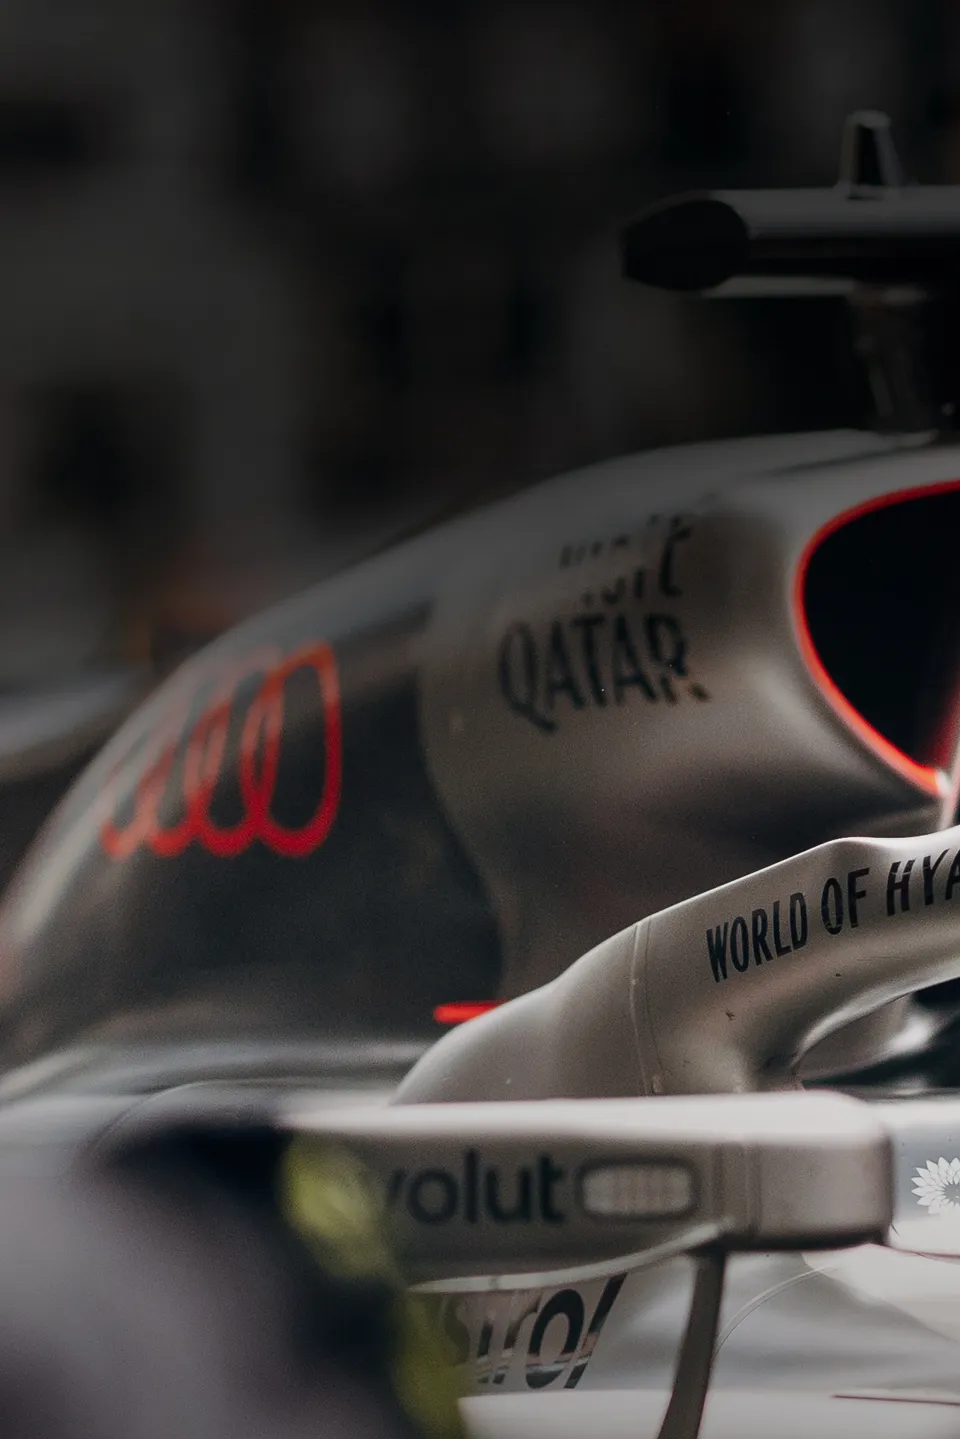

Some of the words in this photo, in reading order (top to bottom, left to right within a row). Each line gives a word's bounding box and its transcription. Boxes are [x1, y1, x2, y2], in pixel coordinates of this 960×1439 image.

[498, 612, 710, 731] QATAR
[706, 892, 808, 983] WORLD
[821, 867, 870, 935] OF
